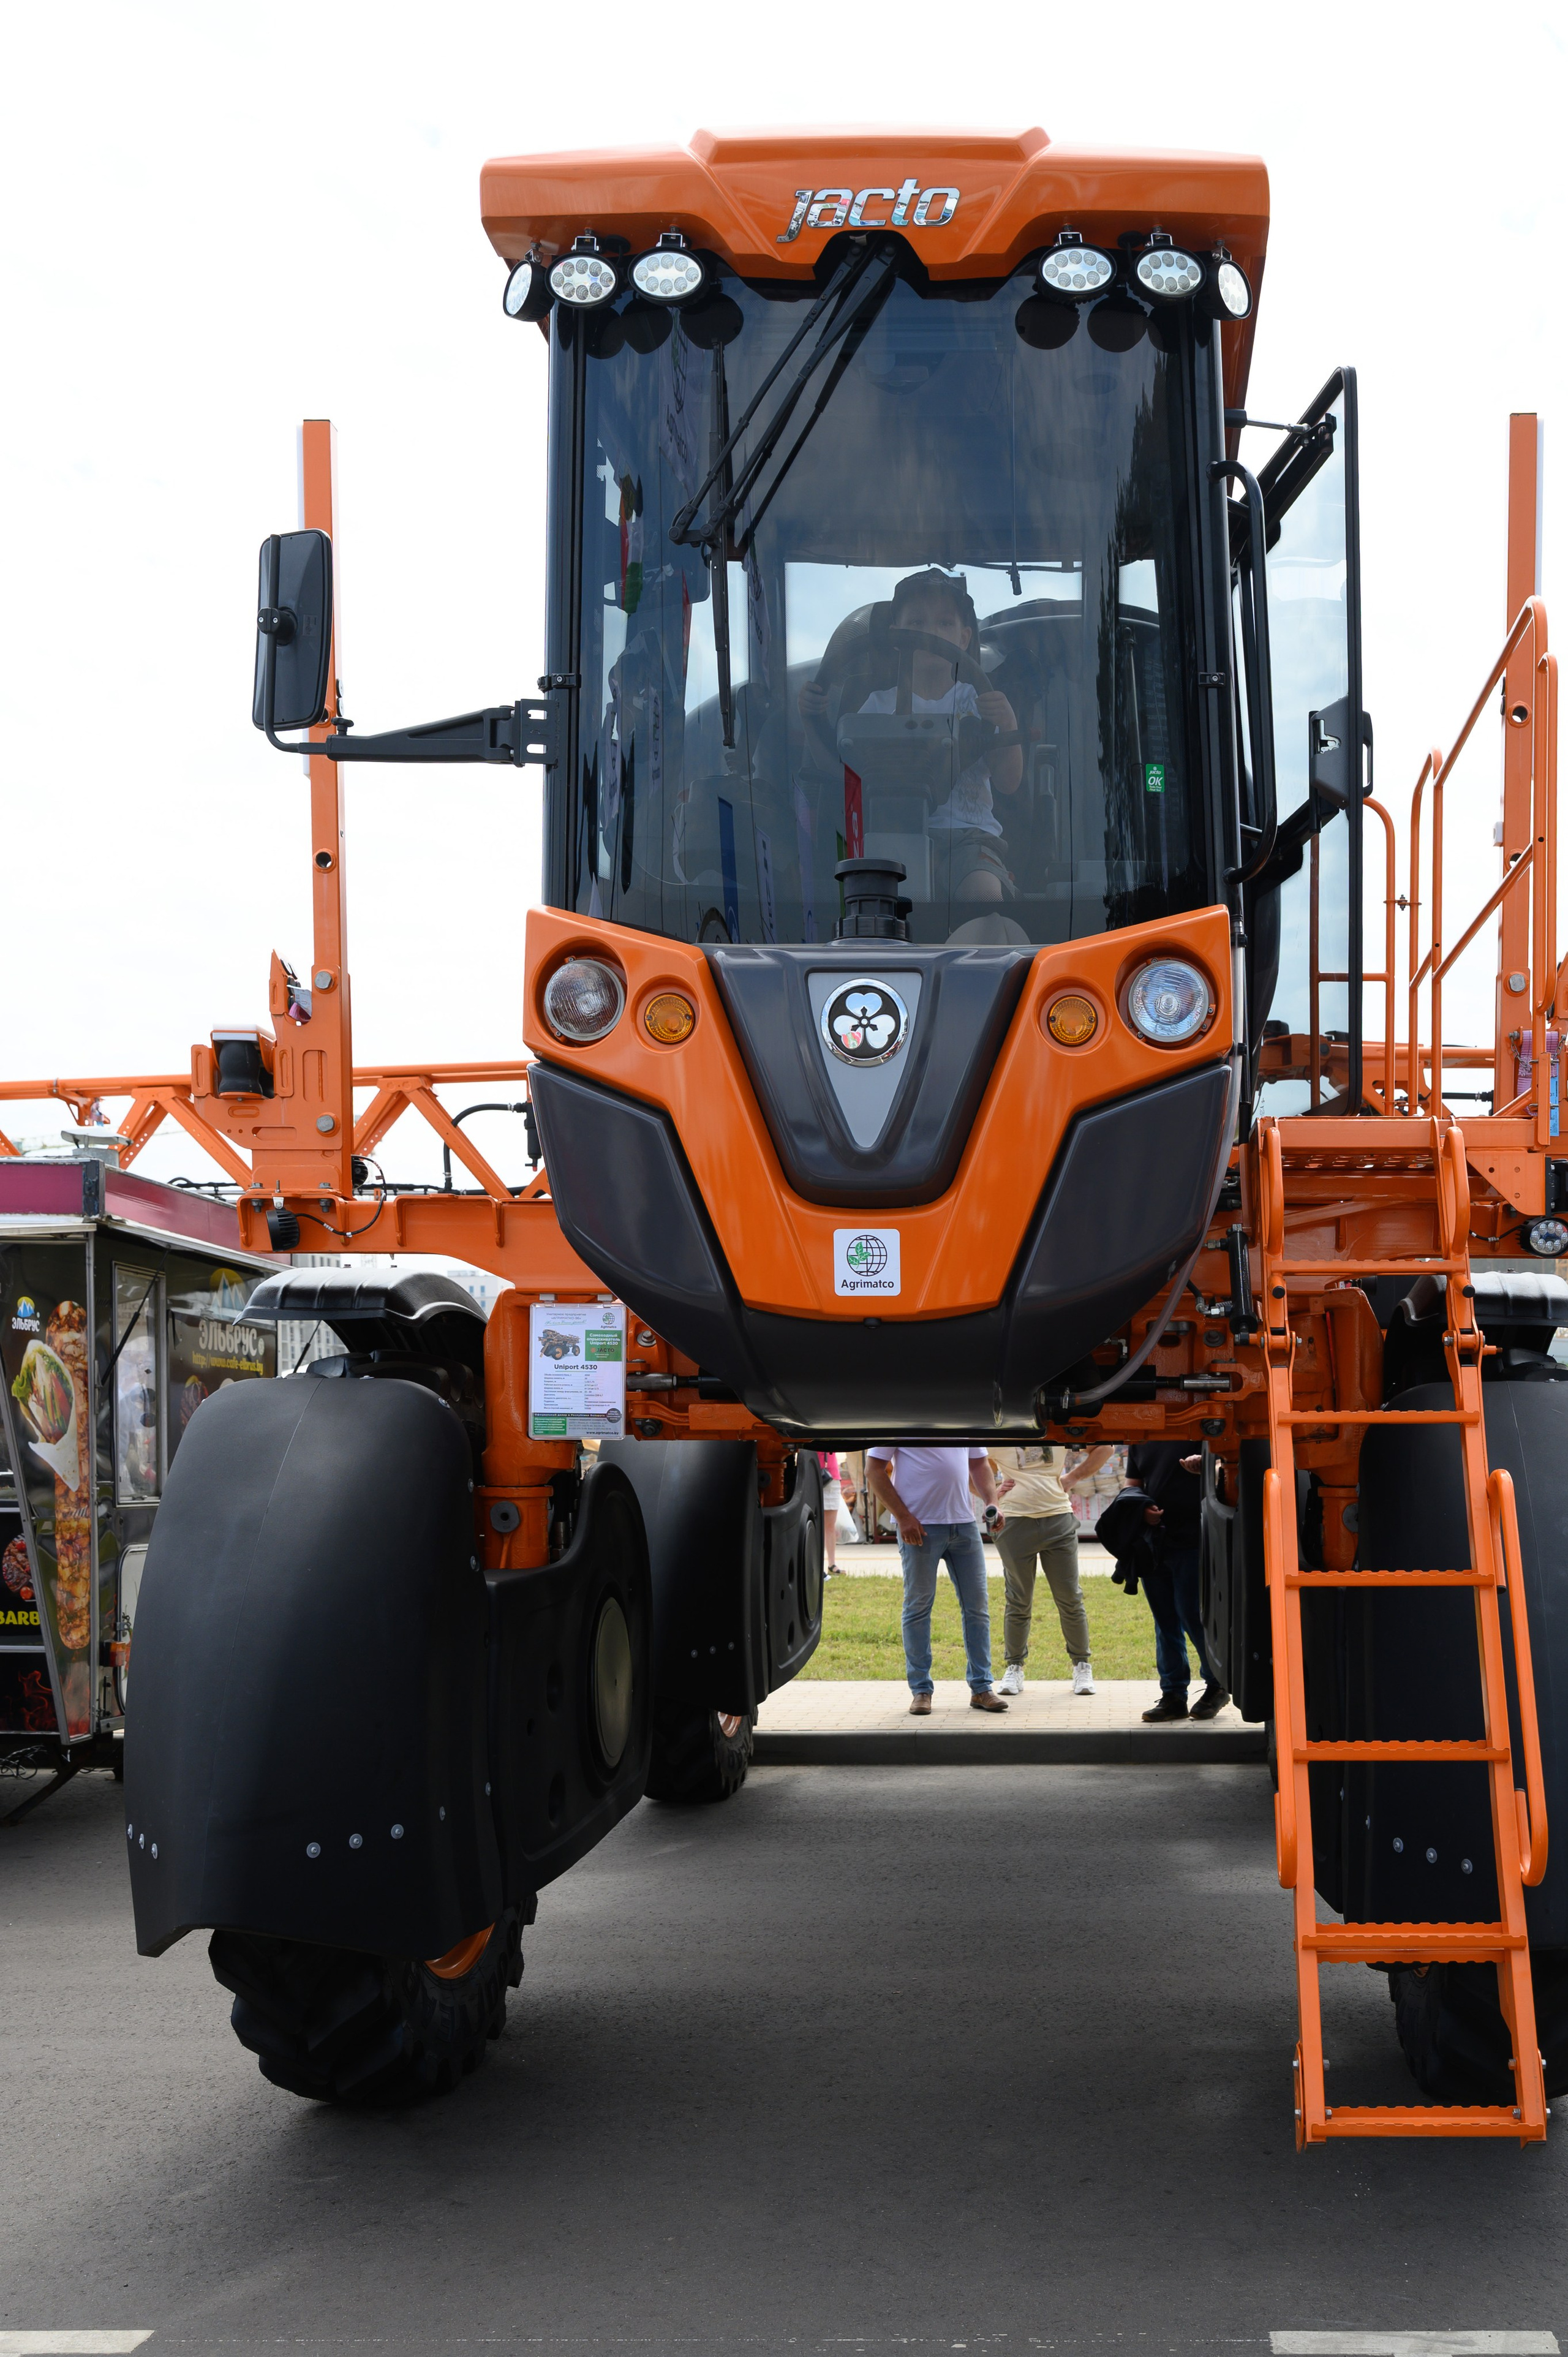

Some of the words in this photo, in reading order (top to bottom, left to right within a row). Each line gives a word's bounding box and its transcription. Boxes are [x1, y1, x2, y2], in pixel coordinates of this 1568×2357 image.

[776, 178, 961, 243] jacto
[1148, 776, 1163, 786] OK
[841, 1279, 894, 1291] Agrimatco
[12, 1317, 40, 1332] ЭЛЬБРУС
[199, 1319, 257, 1356] ЭЛЬБРУС
